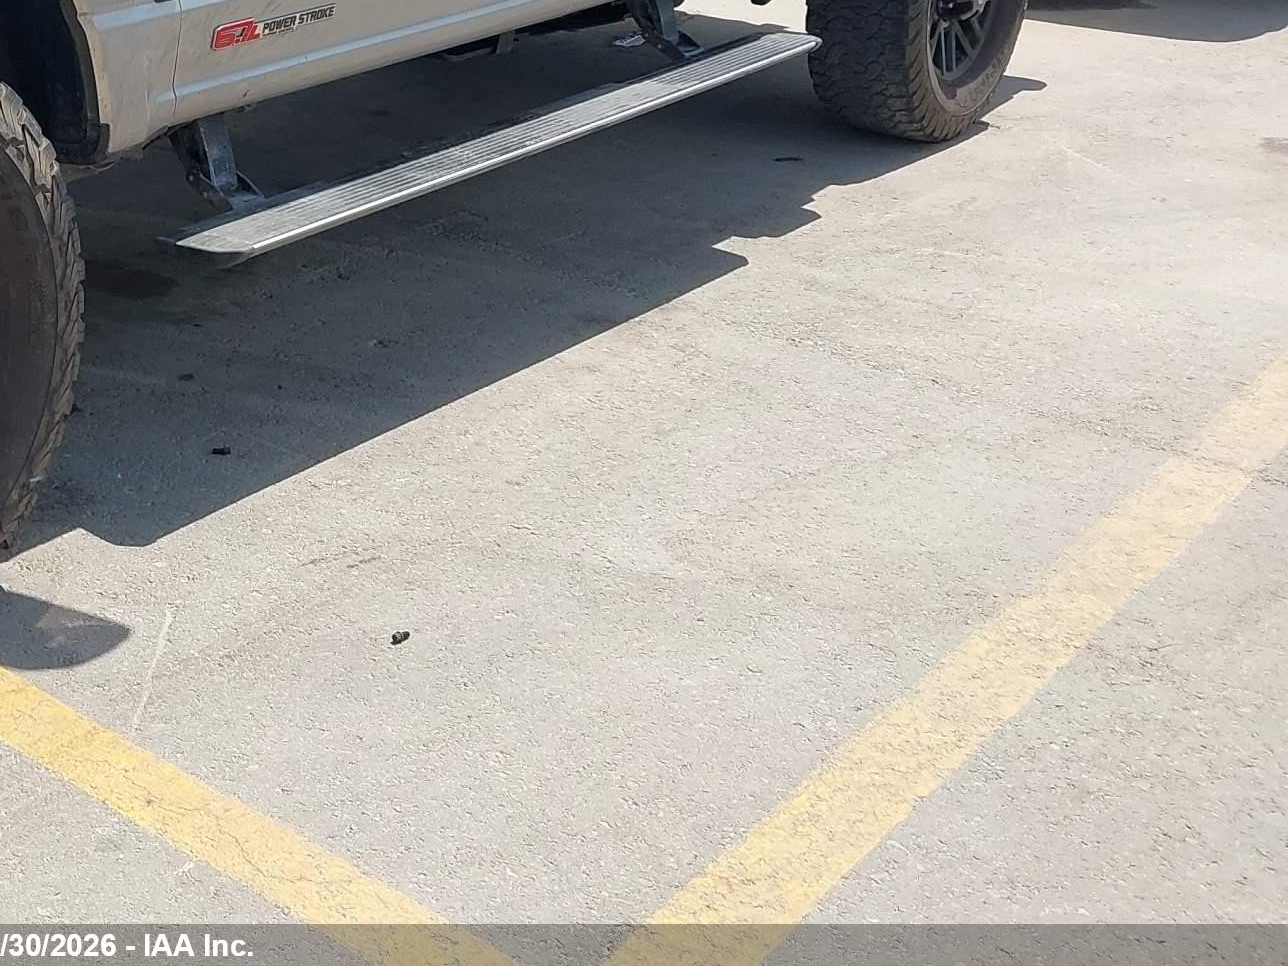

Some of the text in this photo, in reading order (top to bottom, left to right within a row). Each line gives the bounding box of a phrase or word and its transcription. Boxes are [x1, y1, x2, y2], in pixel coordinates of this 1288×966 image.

[212, 17, 262, 50] 6.7L
[261, 15, 297, 34] POWER
[297, 6, 336, 25] STROKE
